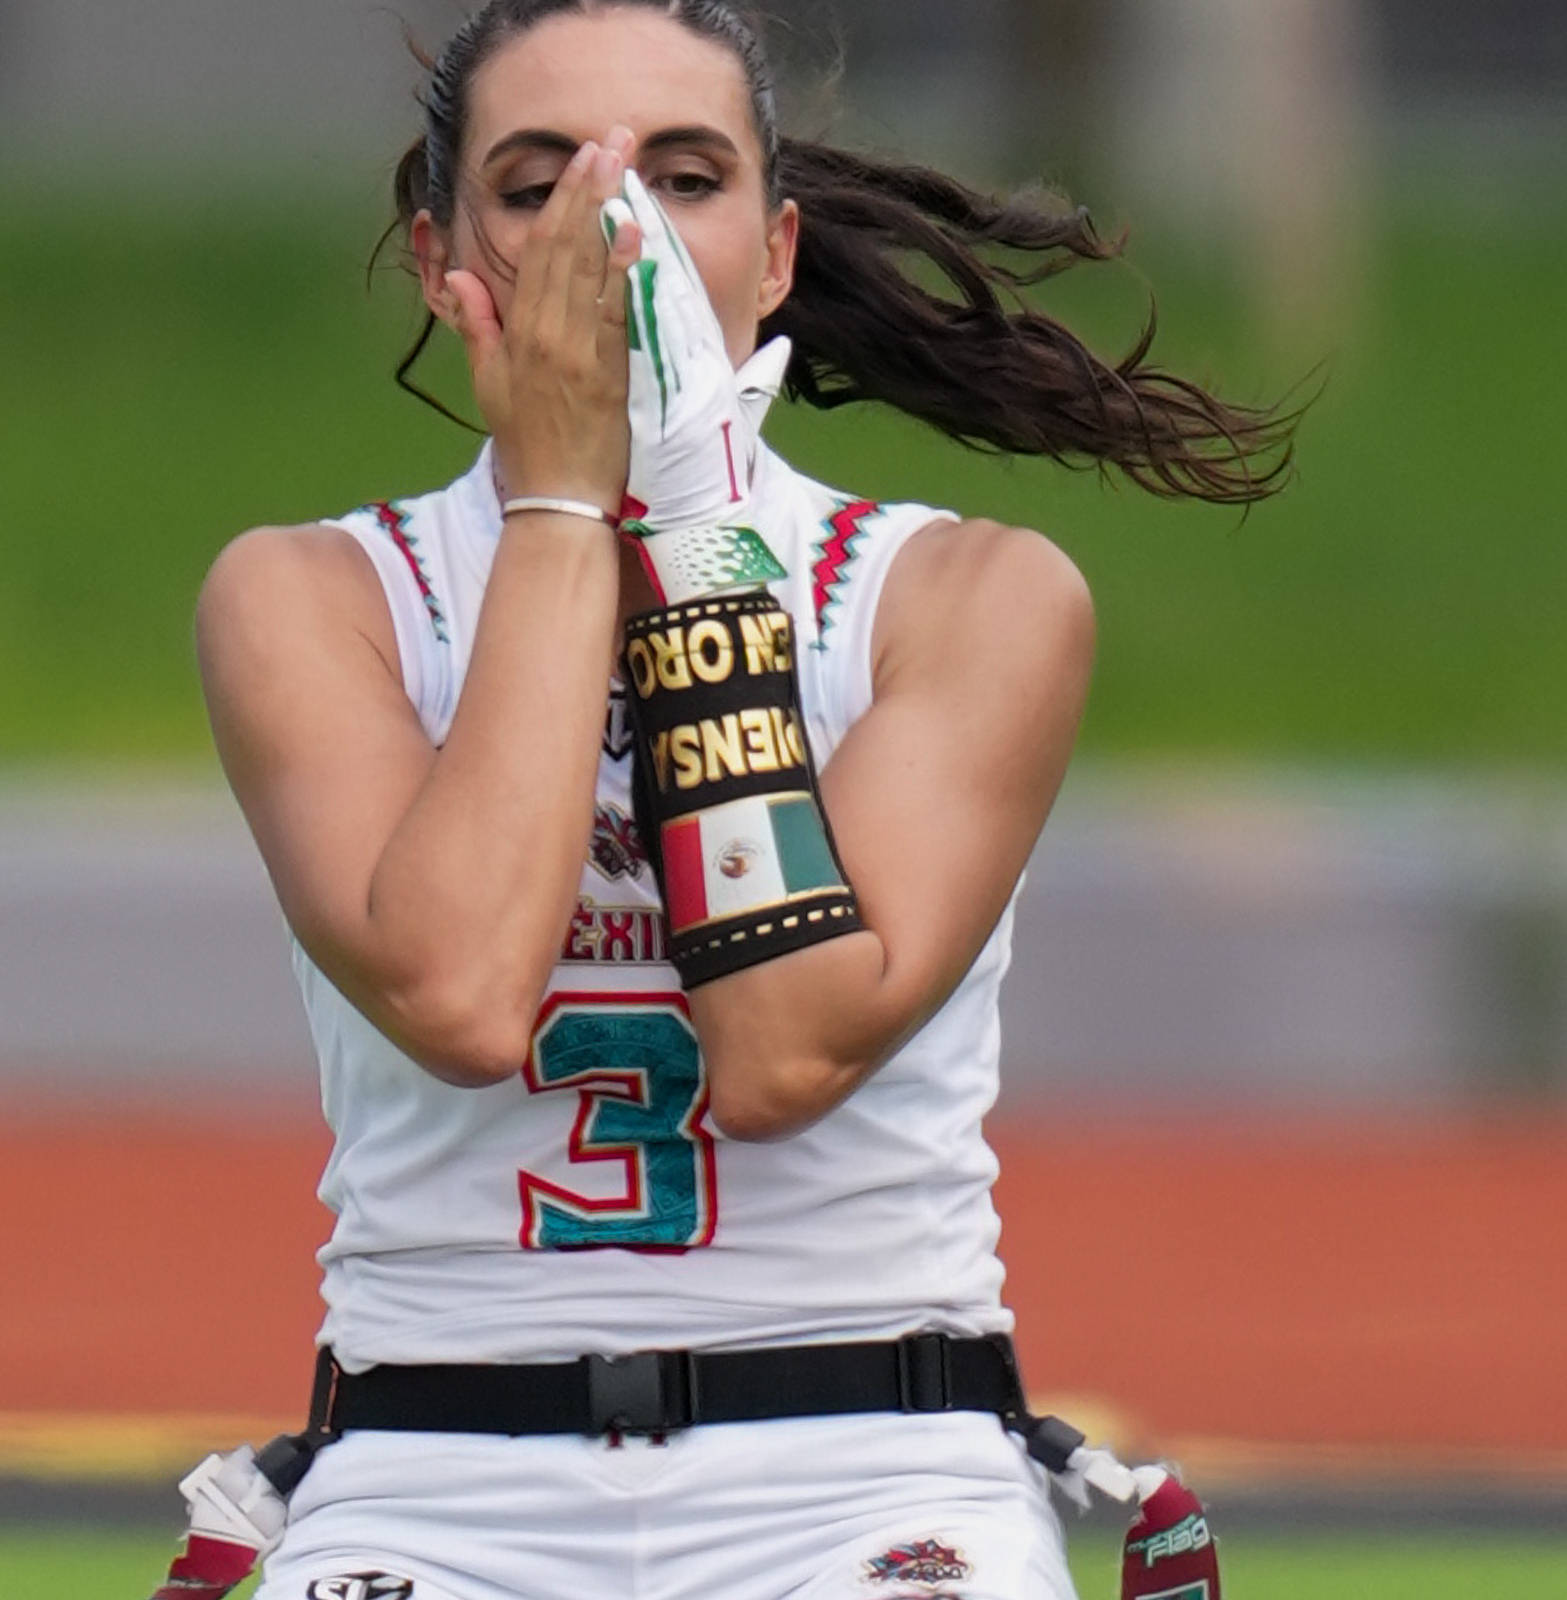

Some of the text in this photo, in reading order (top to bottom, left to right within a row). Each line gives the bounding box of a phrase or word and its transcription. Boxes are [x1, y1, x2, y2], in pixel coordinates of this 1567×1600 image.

[627, 612, 792, 699] EN ORO
[518, 991, 717, 1254] 3
